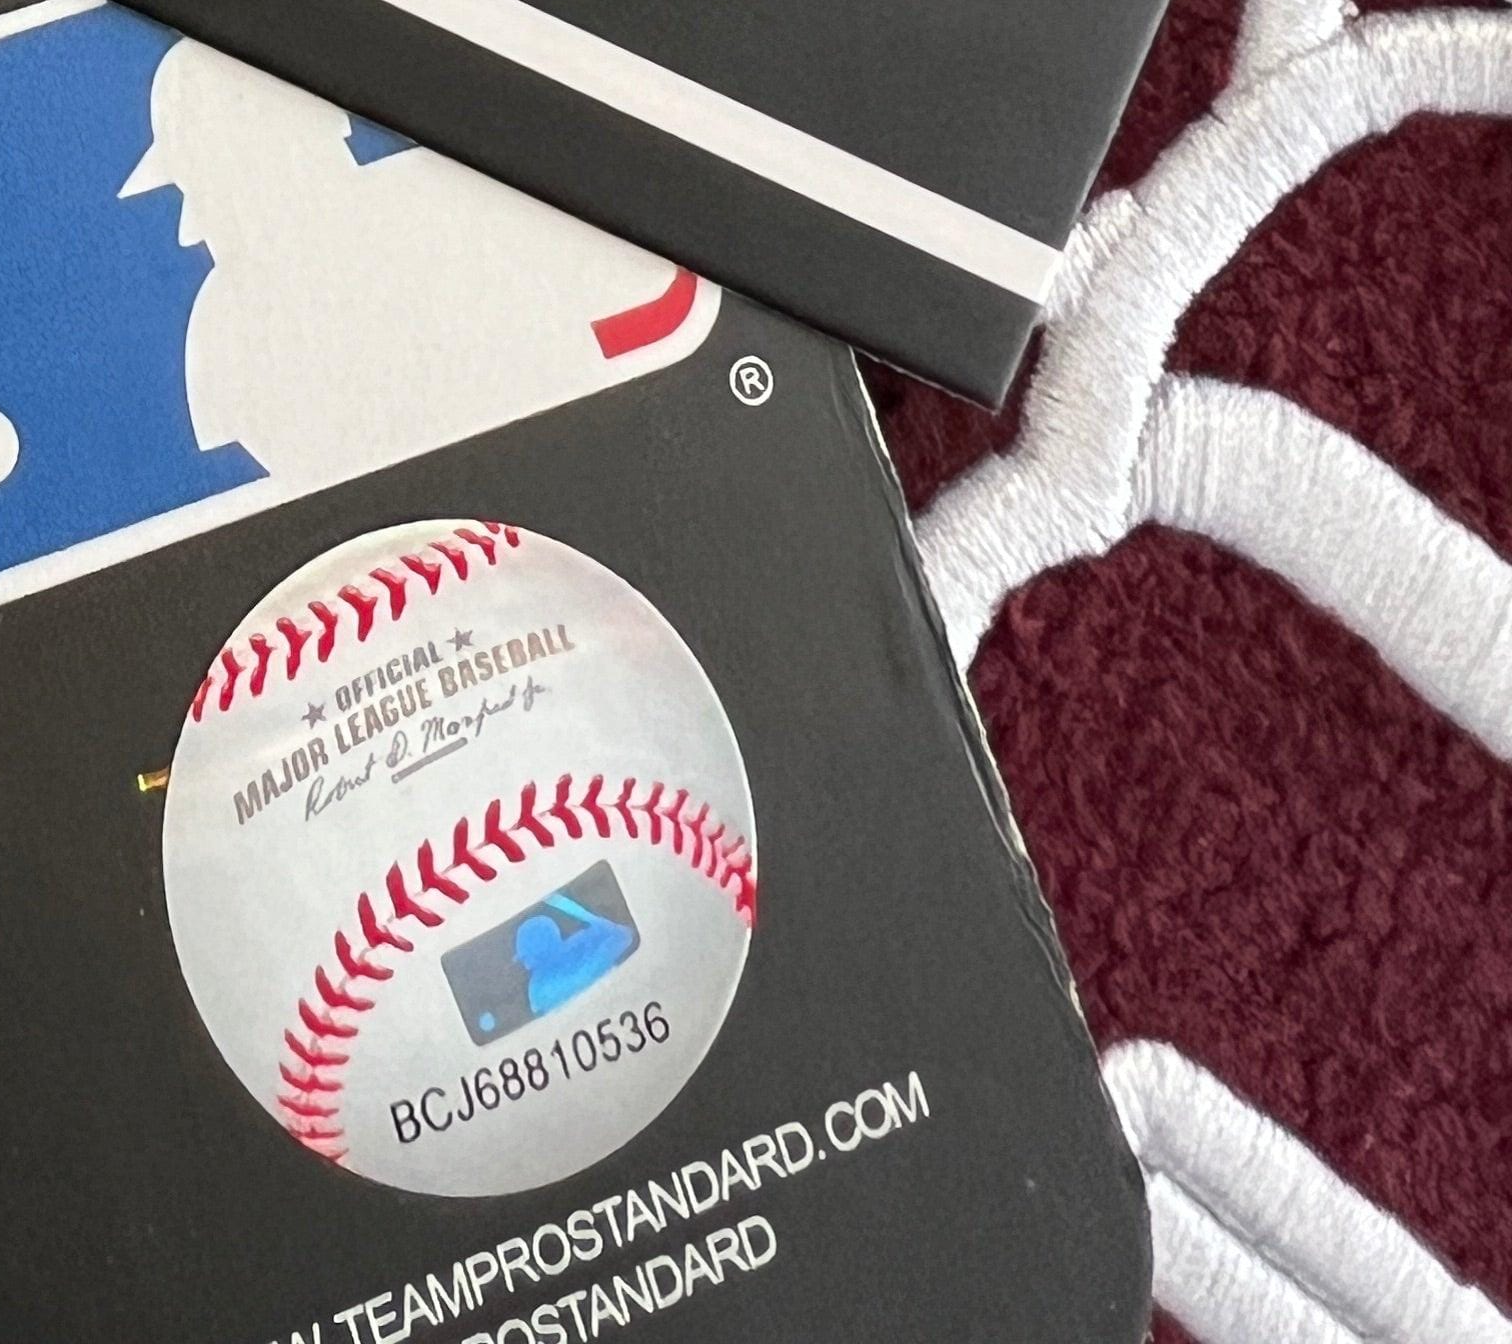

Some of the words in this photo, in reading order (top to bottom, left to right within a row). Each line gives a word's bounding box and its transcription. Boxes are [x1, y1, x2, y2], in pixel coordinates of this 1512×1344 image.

[233, 737, 330, 825] MAJOR
[334, 678, 433, 754] LEAGUE
[437, 624, 575, 699] BASEBALL
[335, 641, 444, 713] OFFICIAL
[391, 1002, 671, 1144] BCJ68810536
[270, 1070, 930, 1344] TEAMPROSTANDARD.COM
